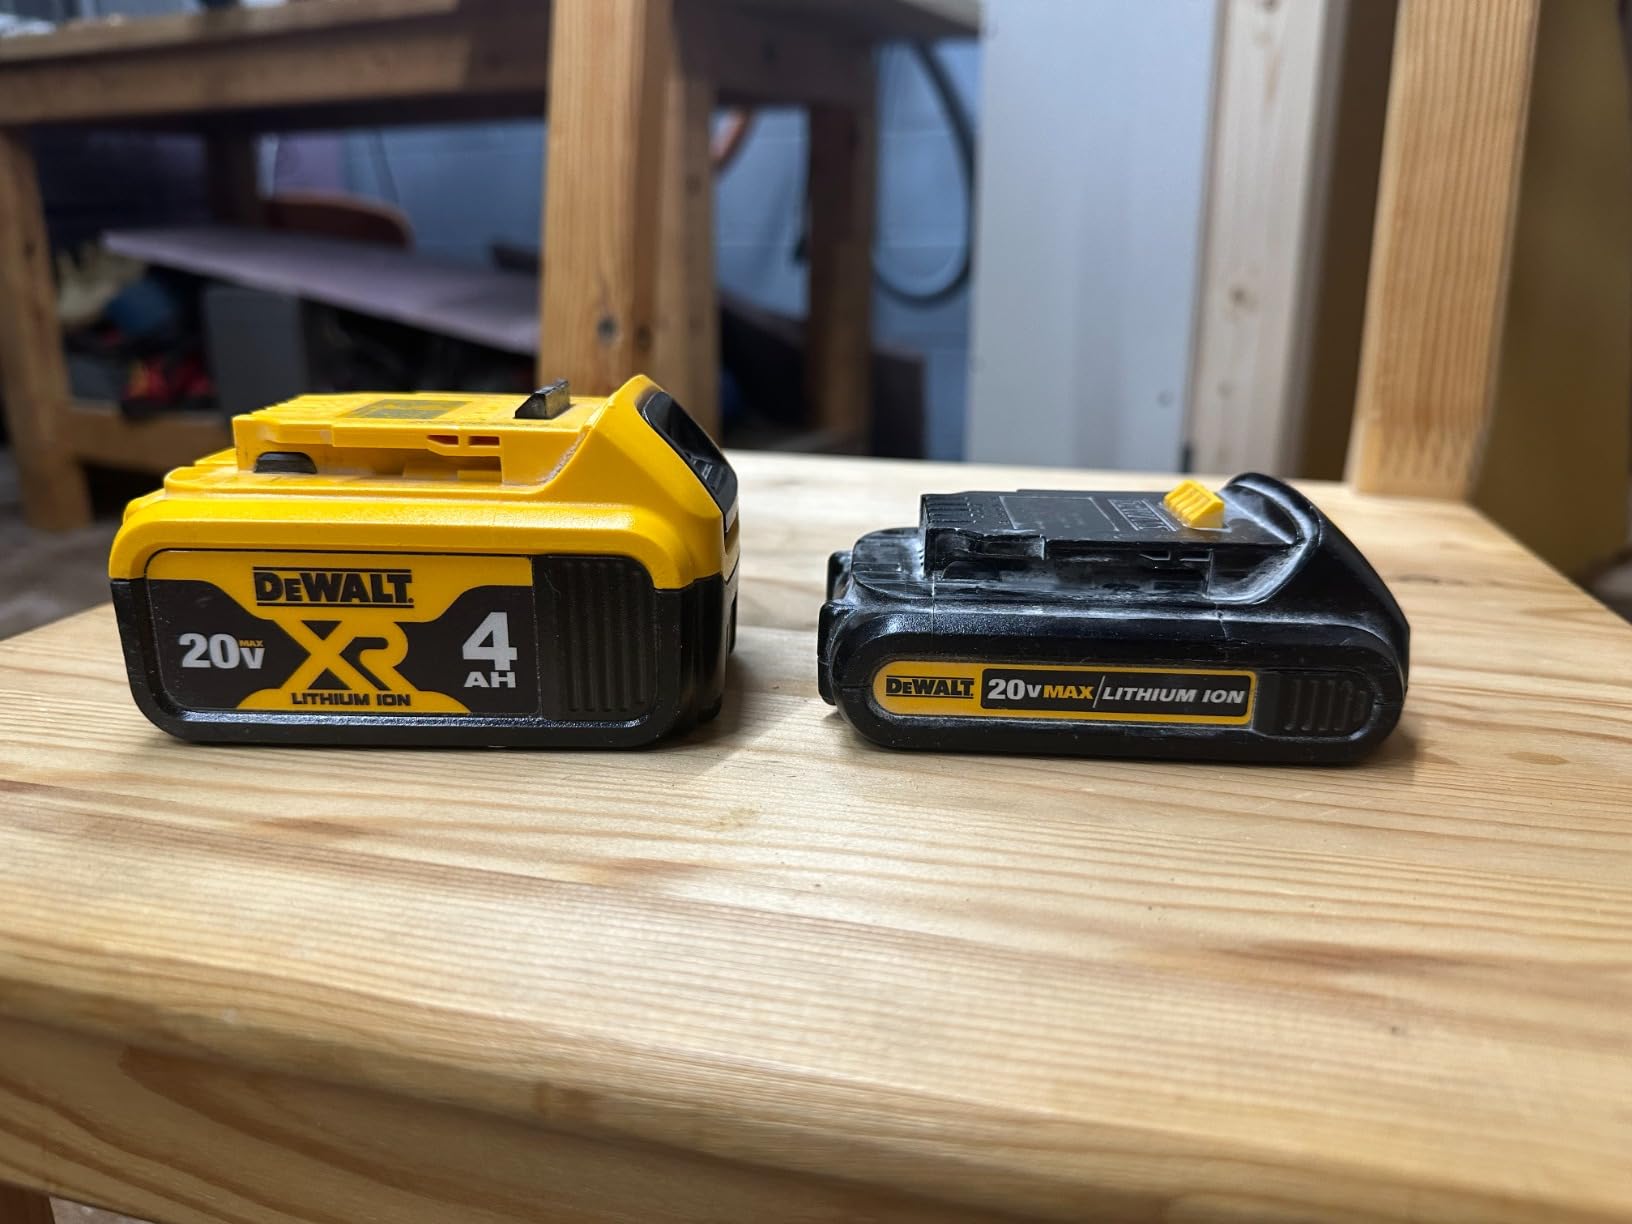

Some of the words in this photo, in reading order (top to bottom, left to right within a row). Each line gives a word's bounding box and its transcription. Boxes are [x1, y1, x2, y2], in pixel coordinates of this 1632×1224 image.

[239, 640, 264, 648] MAX
[462, 612, 517, 671] 4
[279, 620, 418, 692] XR
[464, 671, 516, 688] AH
[291, 692, 370, 706] LITHIUM
[376, 693, 411, 706] ION
[1202, 690, 1245, 704] ION
